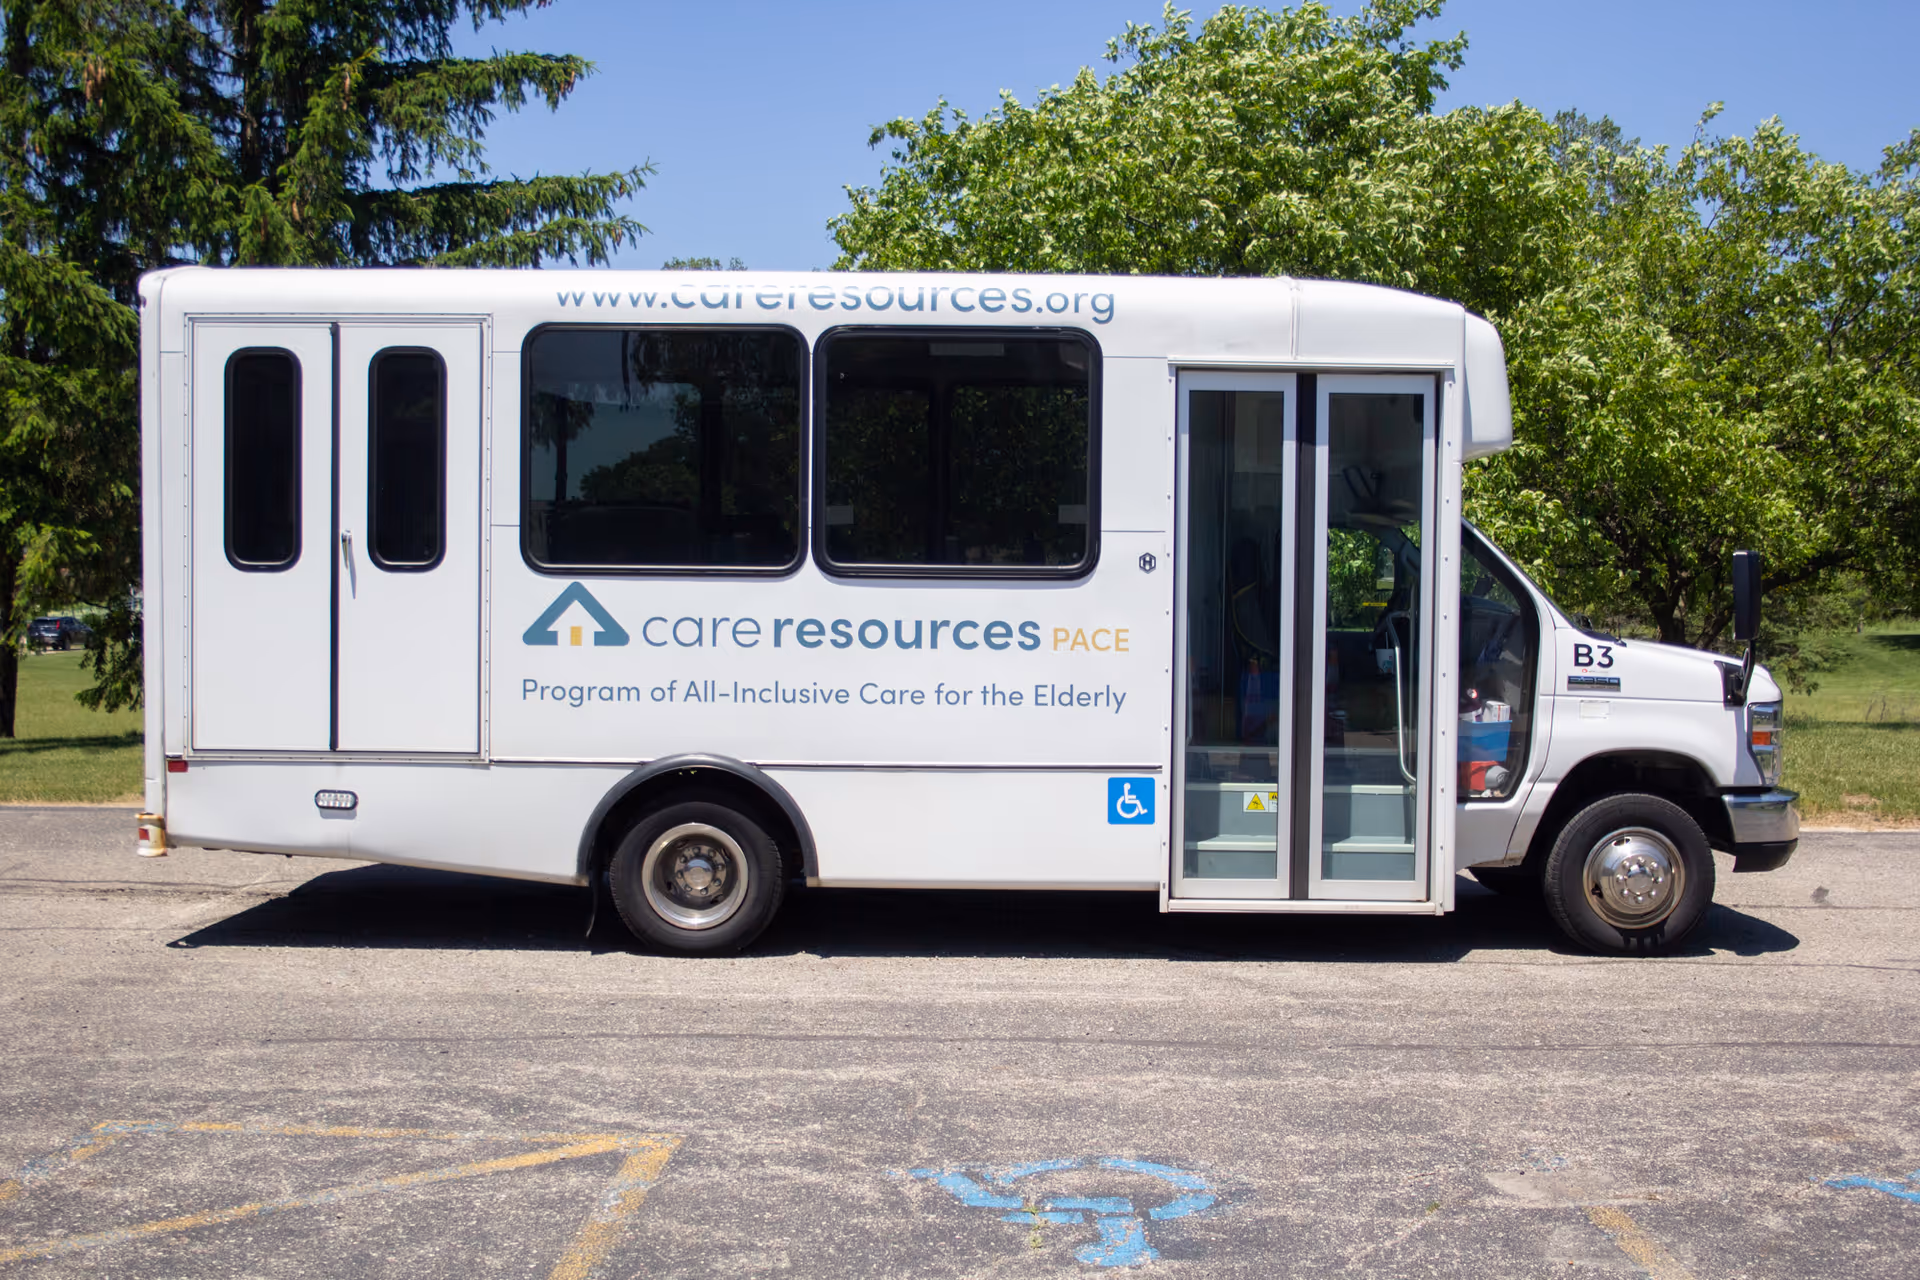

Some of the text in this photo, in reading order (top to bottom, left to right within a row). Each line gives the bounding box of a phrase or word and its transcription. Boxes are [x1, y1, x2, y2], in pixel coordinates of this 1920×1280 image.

[556, 284, 1115, 324] www.careresources.org
[642, 616, 1130, 652] care resources PACE
[1573, 643, 1614, 668] B3
[522, 679, 1127, 714] Program of All-Inclusive Care for the Elderly
